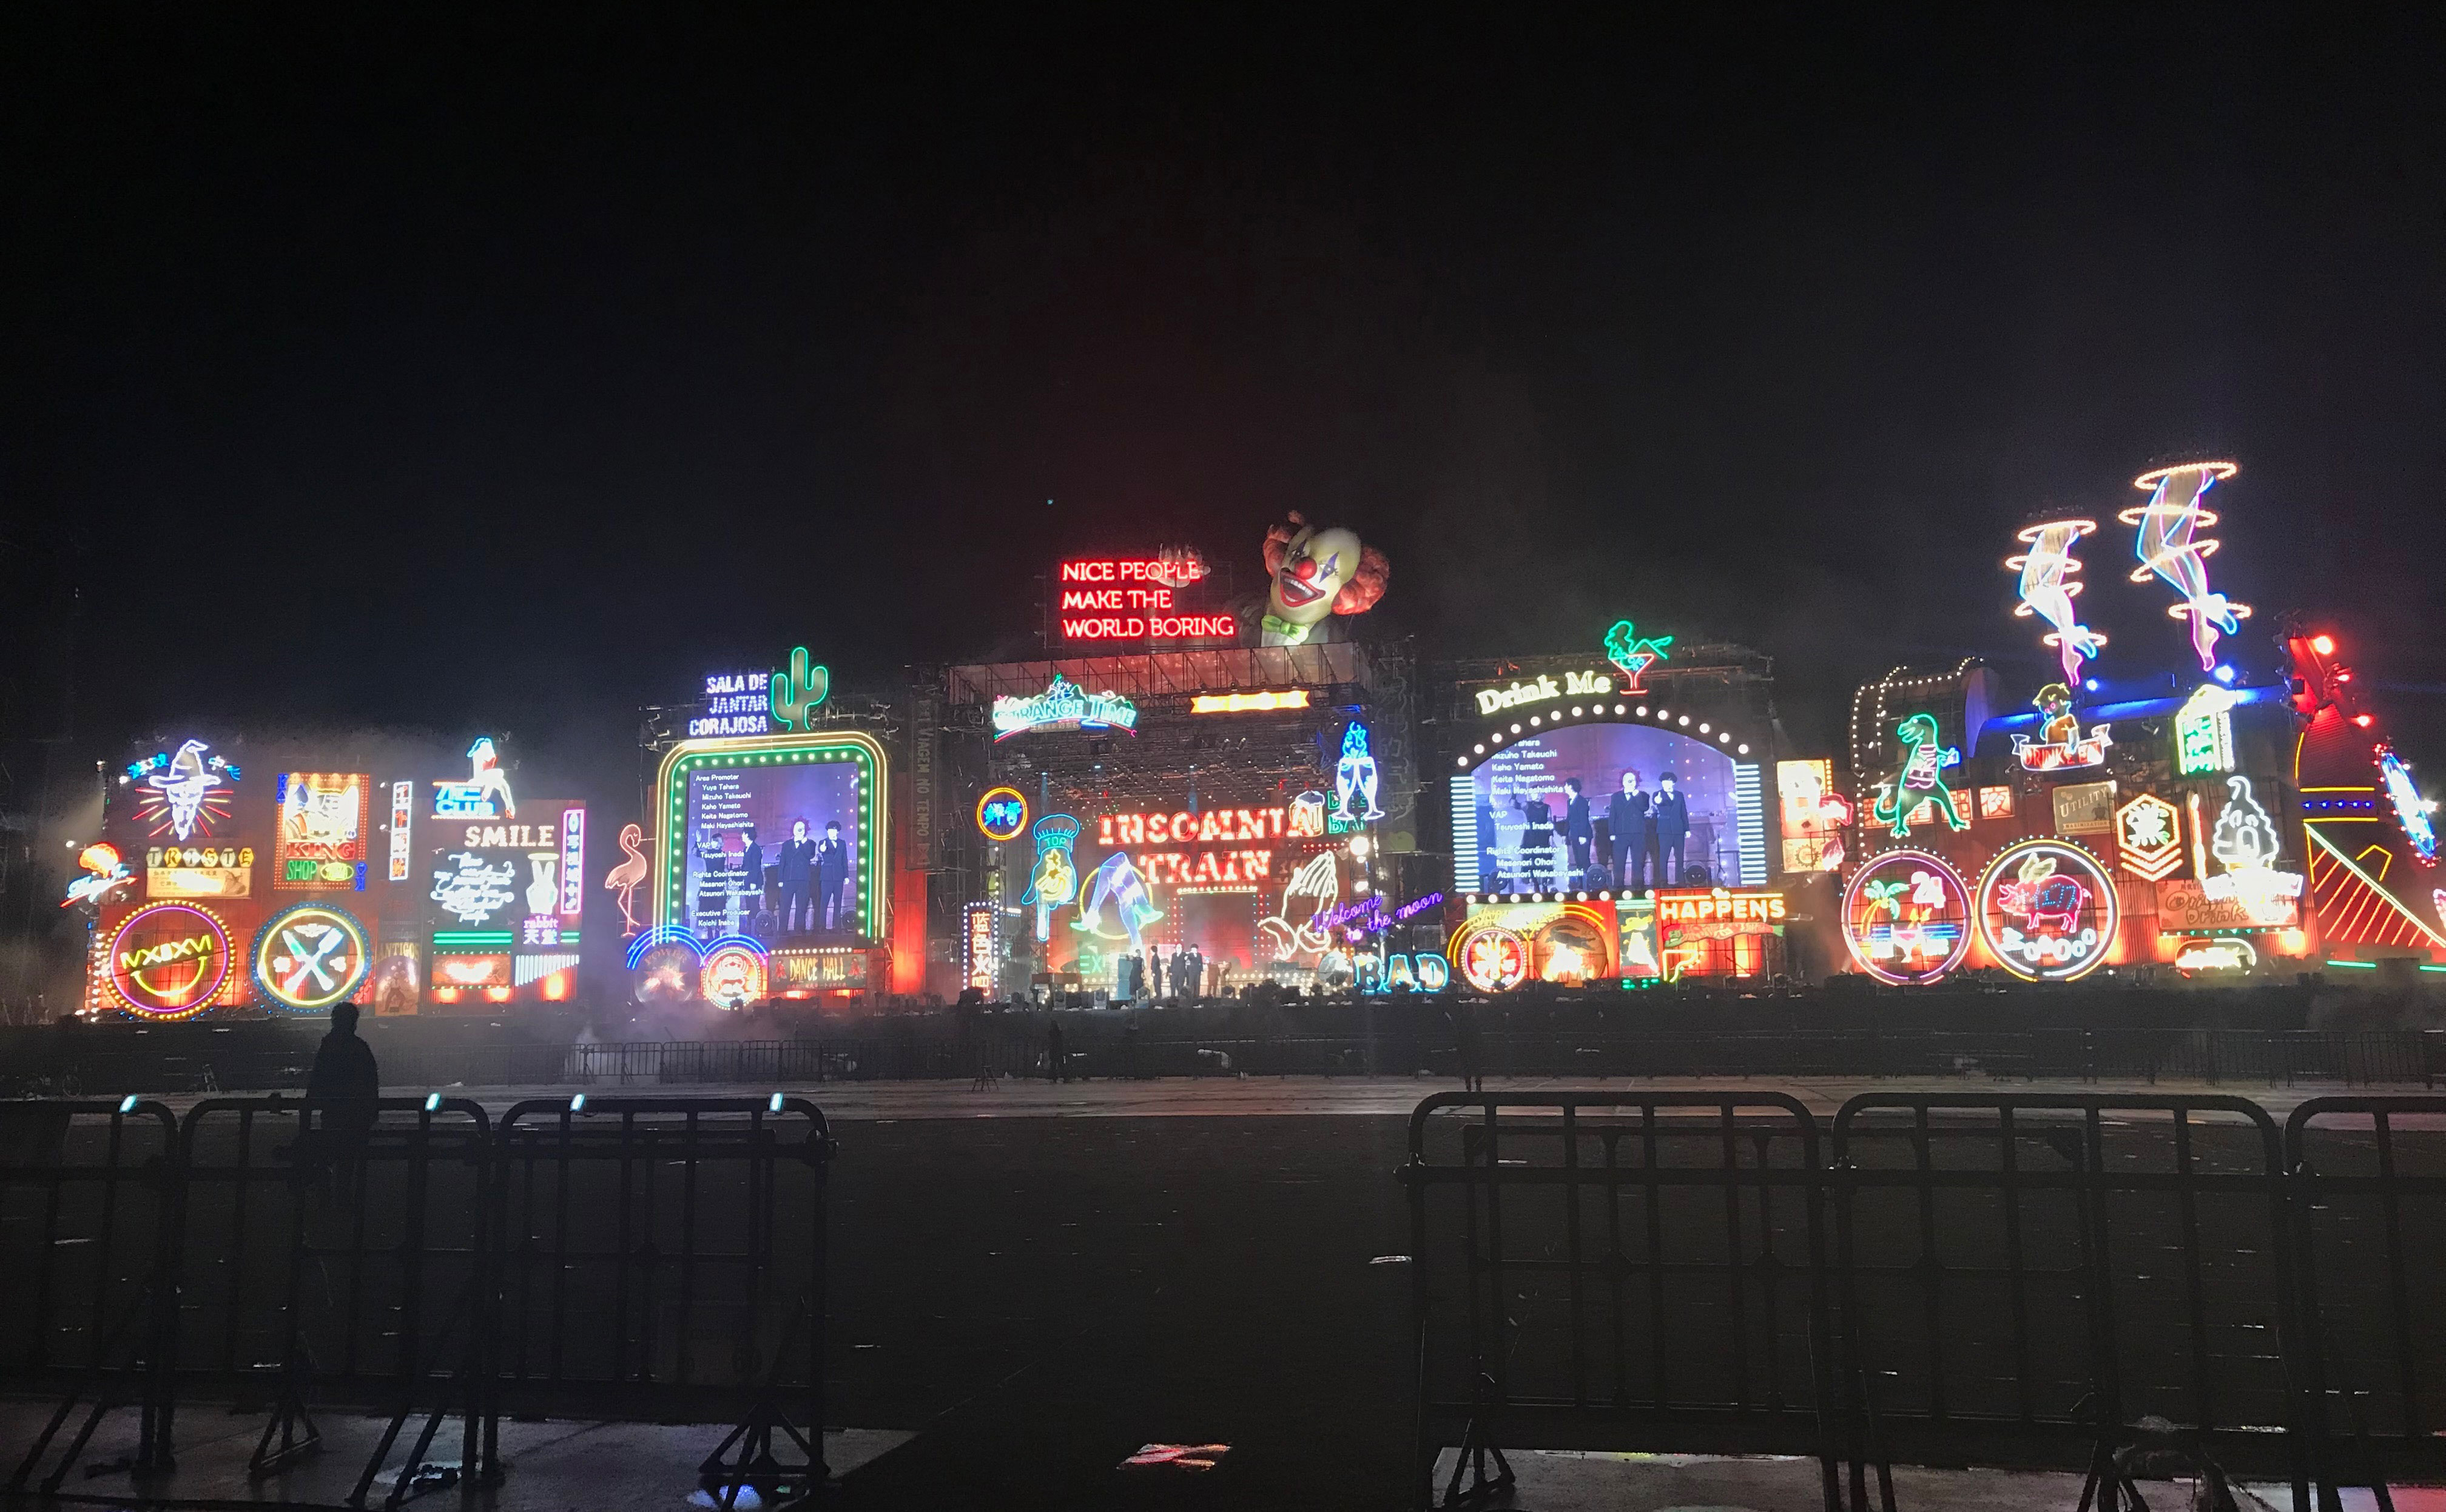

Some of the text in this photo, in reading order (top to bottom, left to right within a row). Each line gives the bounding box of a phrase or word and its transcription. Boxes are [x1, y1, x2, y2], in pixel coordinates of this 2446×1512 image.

[1063, 560, 1201, 580] NICE PEOPLE
[1063, 590, 1171, 610] MAKE THE
[1063, 616, 1234, 637] WORLD BORING
[707, 674, 768, 694] SALA DE
[1476, 670, 1611, 714] Drink Me
[709, 694, 767, 714] JANTAR
[1090, 695, 1137, 727] TIME
[689, 716, 767, 736] CORAJOSA
[1521, 749, 1557, 758] Takeuchi
[2024, 745, 2066, 769] DRINK
[916, 728, 934, 837] VIAGEM NO TEMPO
[1515, 774, 1555, 784] Nagatomo
[2060, 787, 2107, 818] UTILITY
[1098, 805, 1315, 844] INSOMNIA
[464, 825, 554, 847] SMILE
[1045, 837, 1066, 847] TOP
[286, 841, 356, 861] KING
[286, 860, 317, 880] SHOP
[1137, 850, 1271, 884] TRAIN
[1312, 895, 1383, 933] Welcome
[1367, 910, 1391, 932] the
[1396, 892, 1443, 920] moon
[1660, 899, 1785, 920] HAPPENS
[524, 916, 558, 929] rabbit
[790, 956, 846, 981] DANCE HALL
[1353, 953, 1449, 994] BAD
